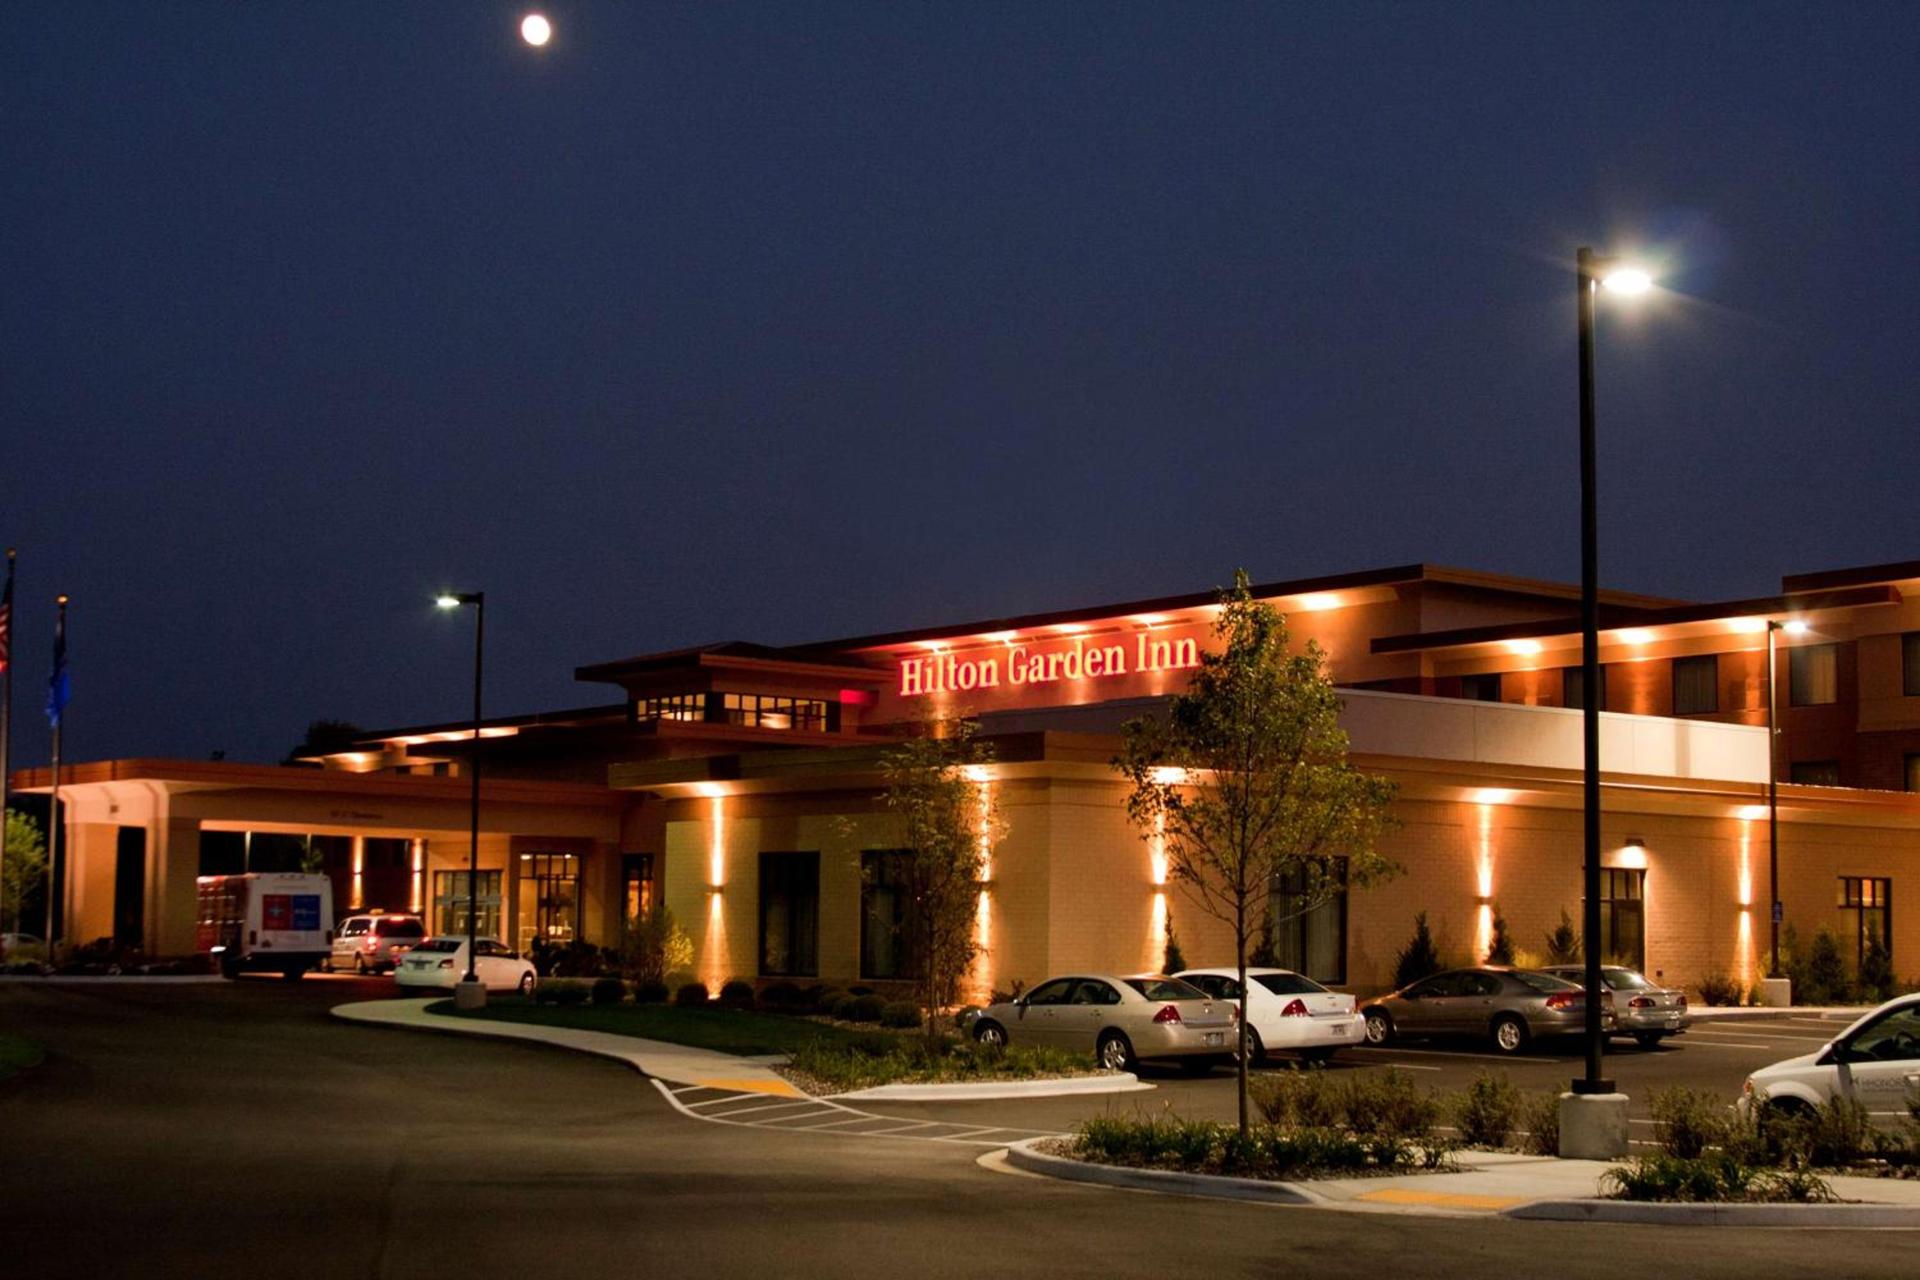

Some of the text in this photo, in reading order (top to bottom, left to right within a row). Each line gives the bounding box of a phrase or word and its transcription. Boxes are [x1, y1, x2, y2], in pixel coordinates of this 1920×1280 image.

[900, 632, 1199, 695] Hilton Garden Inn
